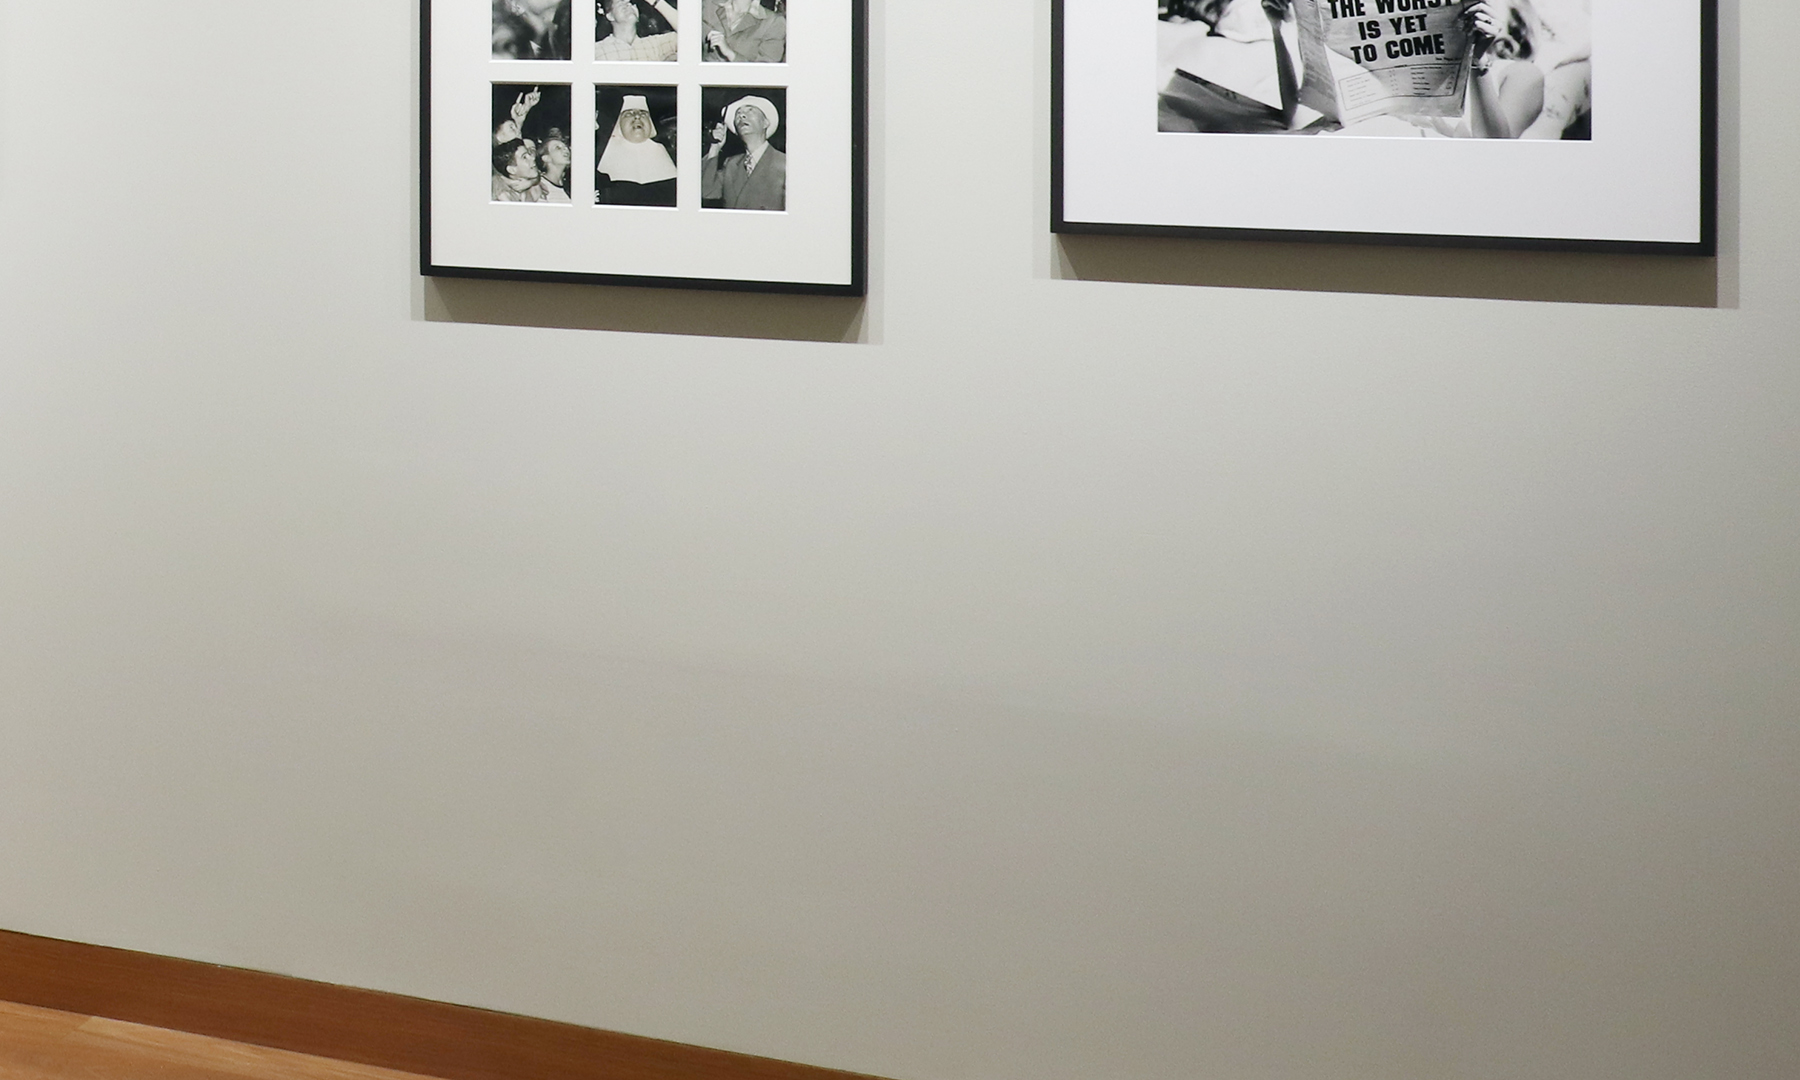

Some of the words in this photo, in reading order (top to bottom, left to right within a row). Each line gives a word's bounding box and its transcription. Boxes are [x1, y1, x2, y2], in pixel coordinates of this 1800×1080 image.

[1358, 20, 1381, 40] IS
[1389, 14, 1427, 35] YET
[1350, 44, 1377, 64] TO
[1385, 34, 1445, 59] COME
